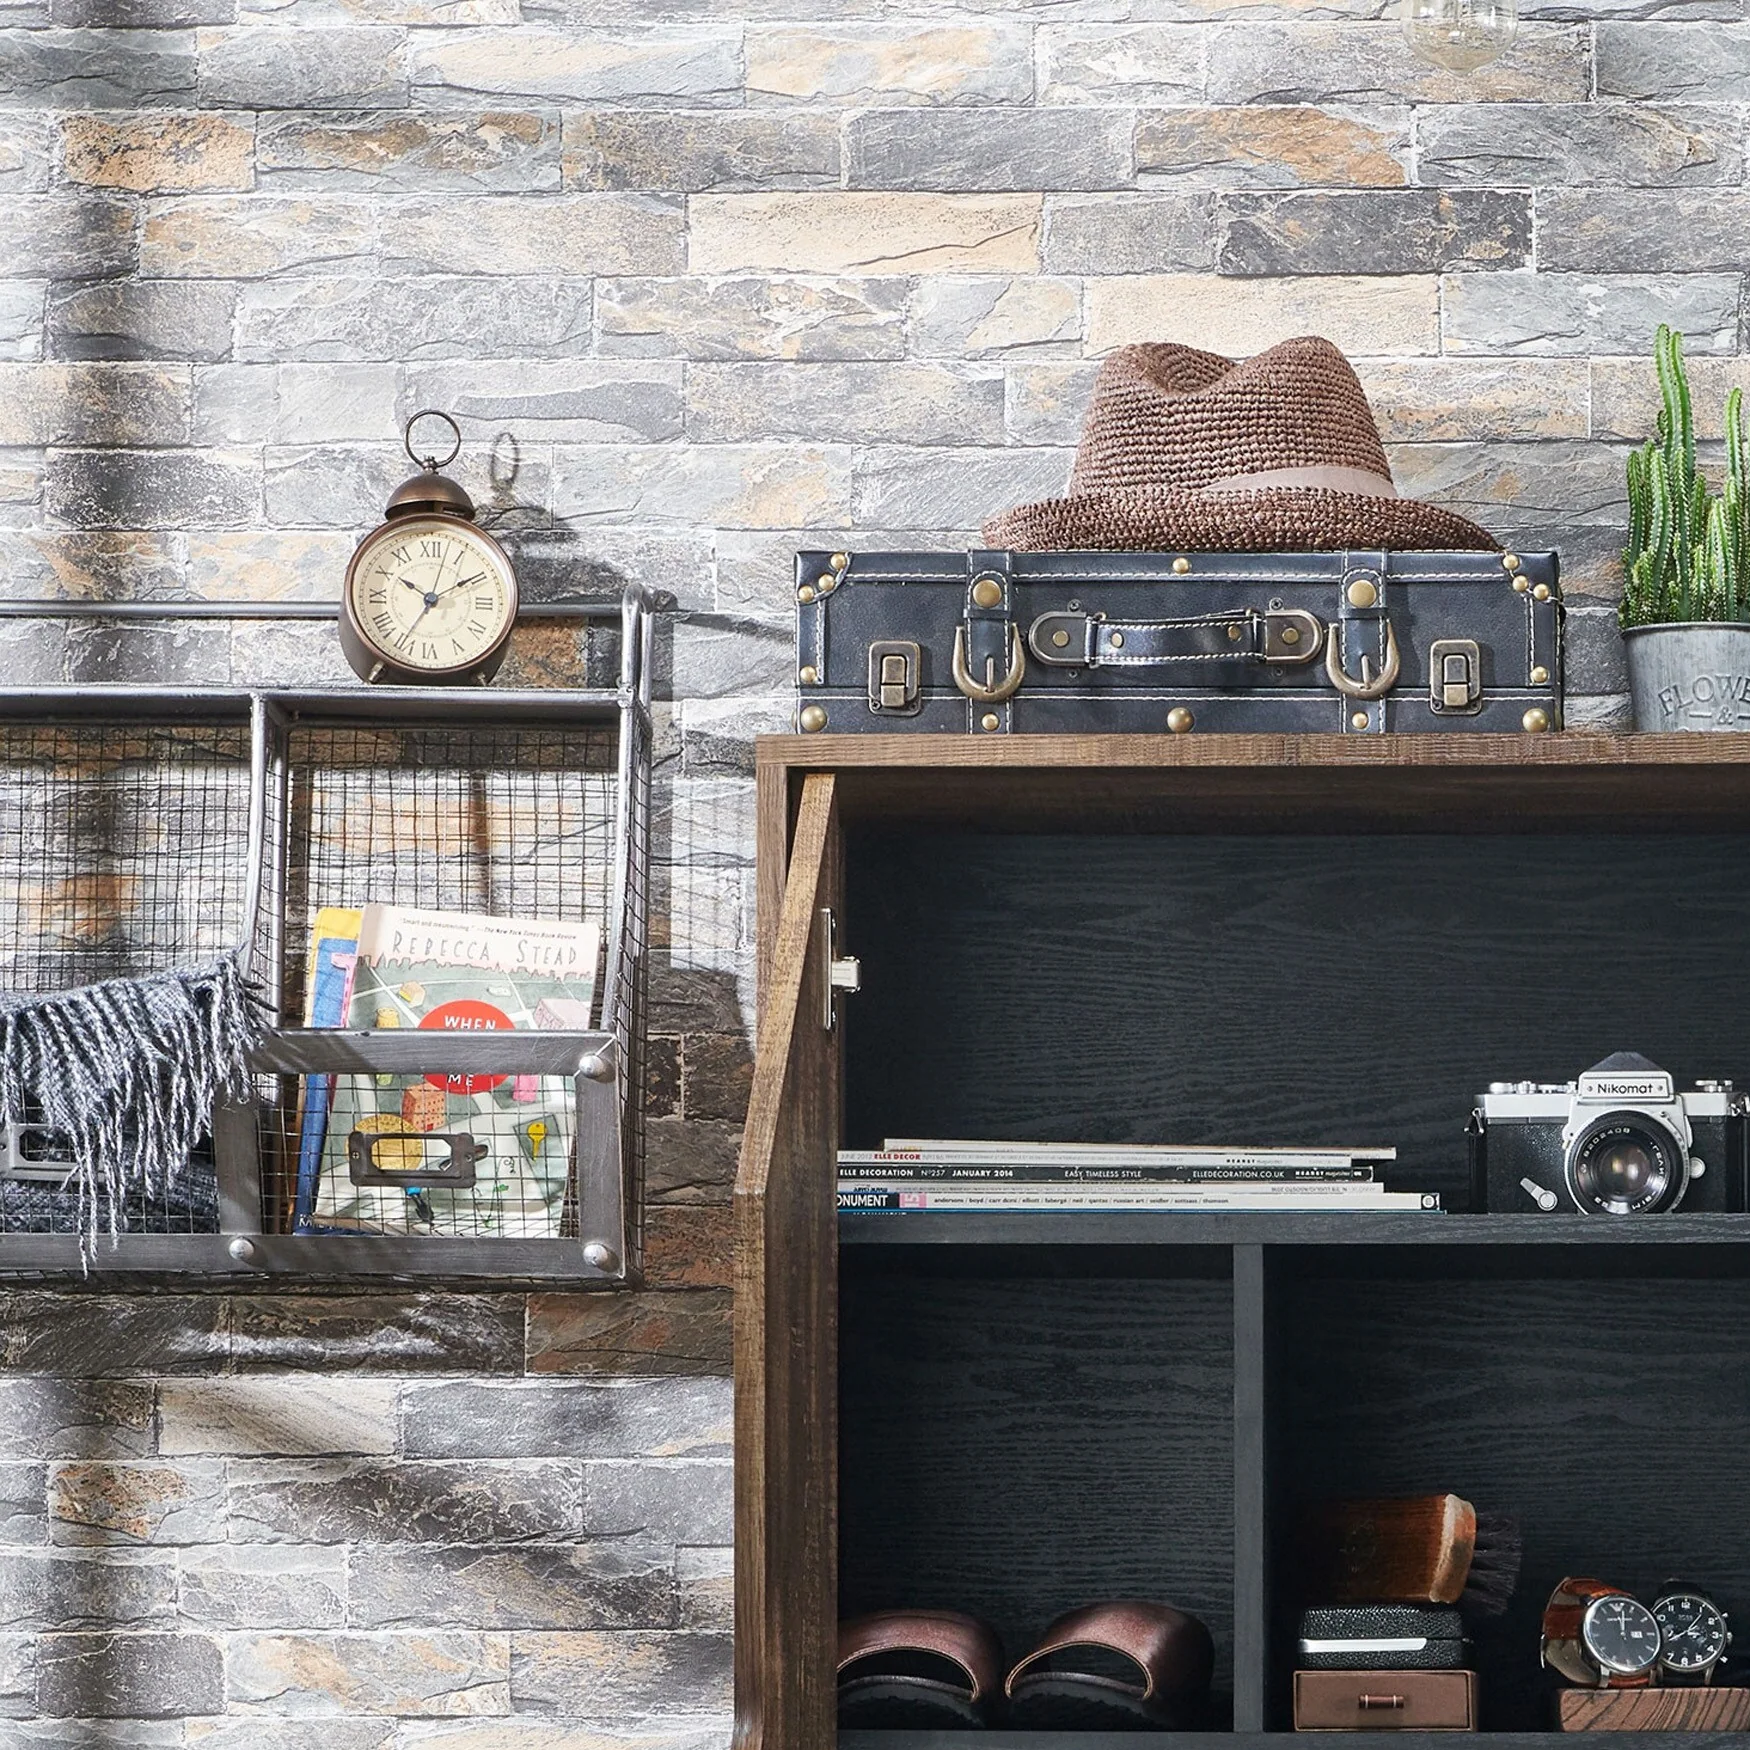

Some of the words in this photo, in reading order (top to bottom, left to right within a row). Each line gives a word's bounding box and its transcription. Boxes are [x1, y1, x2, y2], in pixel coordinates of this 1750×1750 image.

[393, 930, 490, 961] REBECCA
[516, 939, 577, 965] STEAD
[445, 1015, 496, 1029] WHEN
[447, 1074, 474, 1086] ME
[1597, 1083, 1653, 1094] Nikomat
[1064, 1170, 1082, 1178] EASY
[1086, 1170, 1119, 1178] TIMELESS
[1122, 1170, 1142, 1178] STYLE
[1193, 1170, 1285, 1178] ELLEDECORATION.CO.UK
